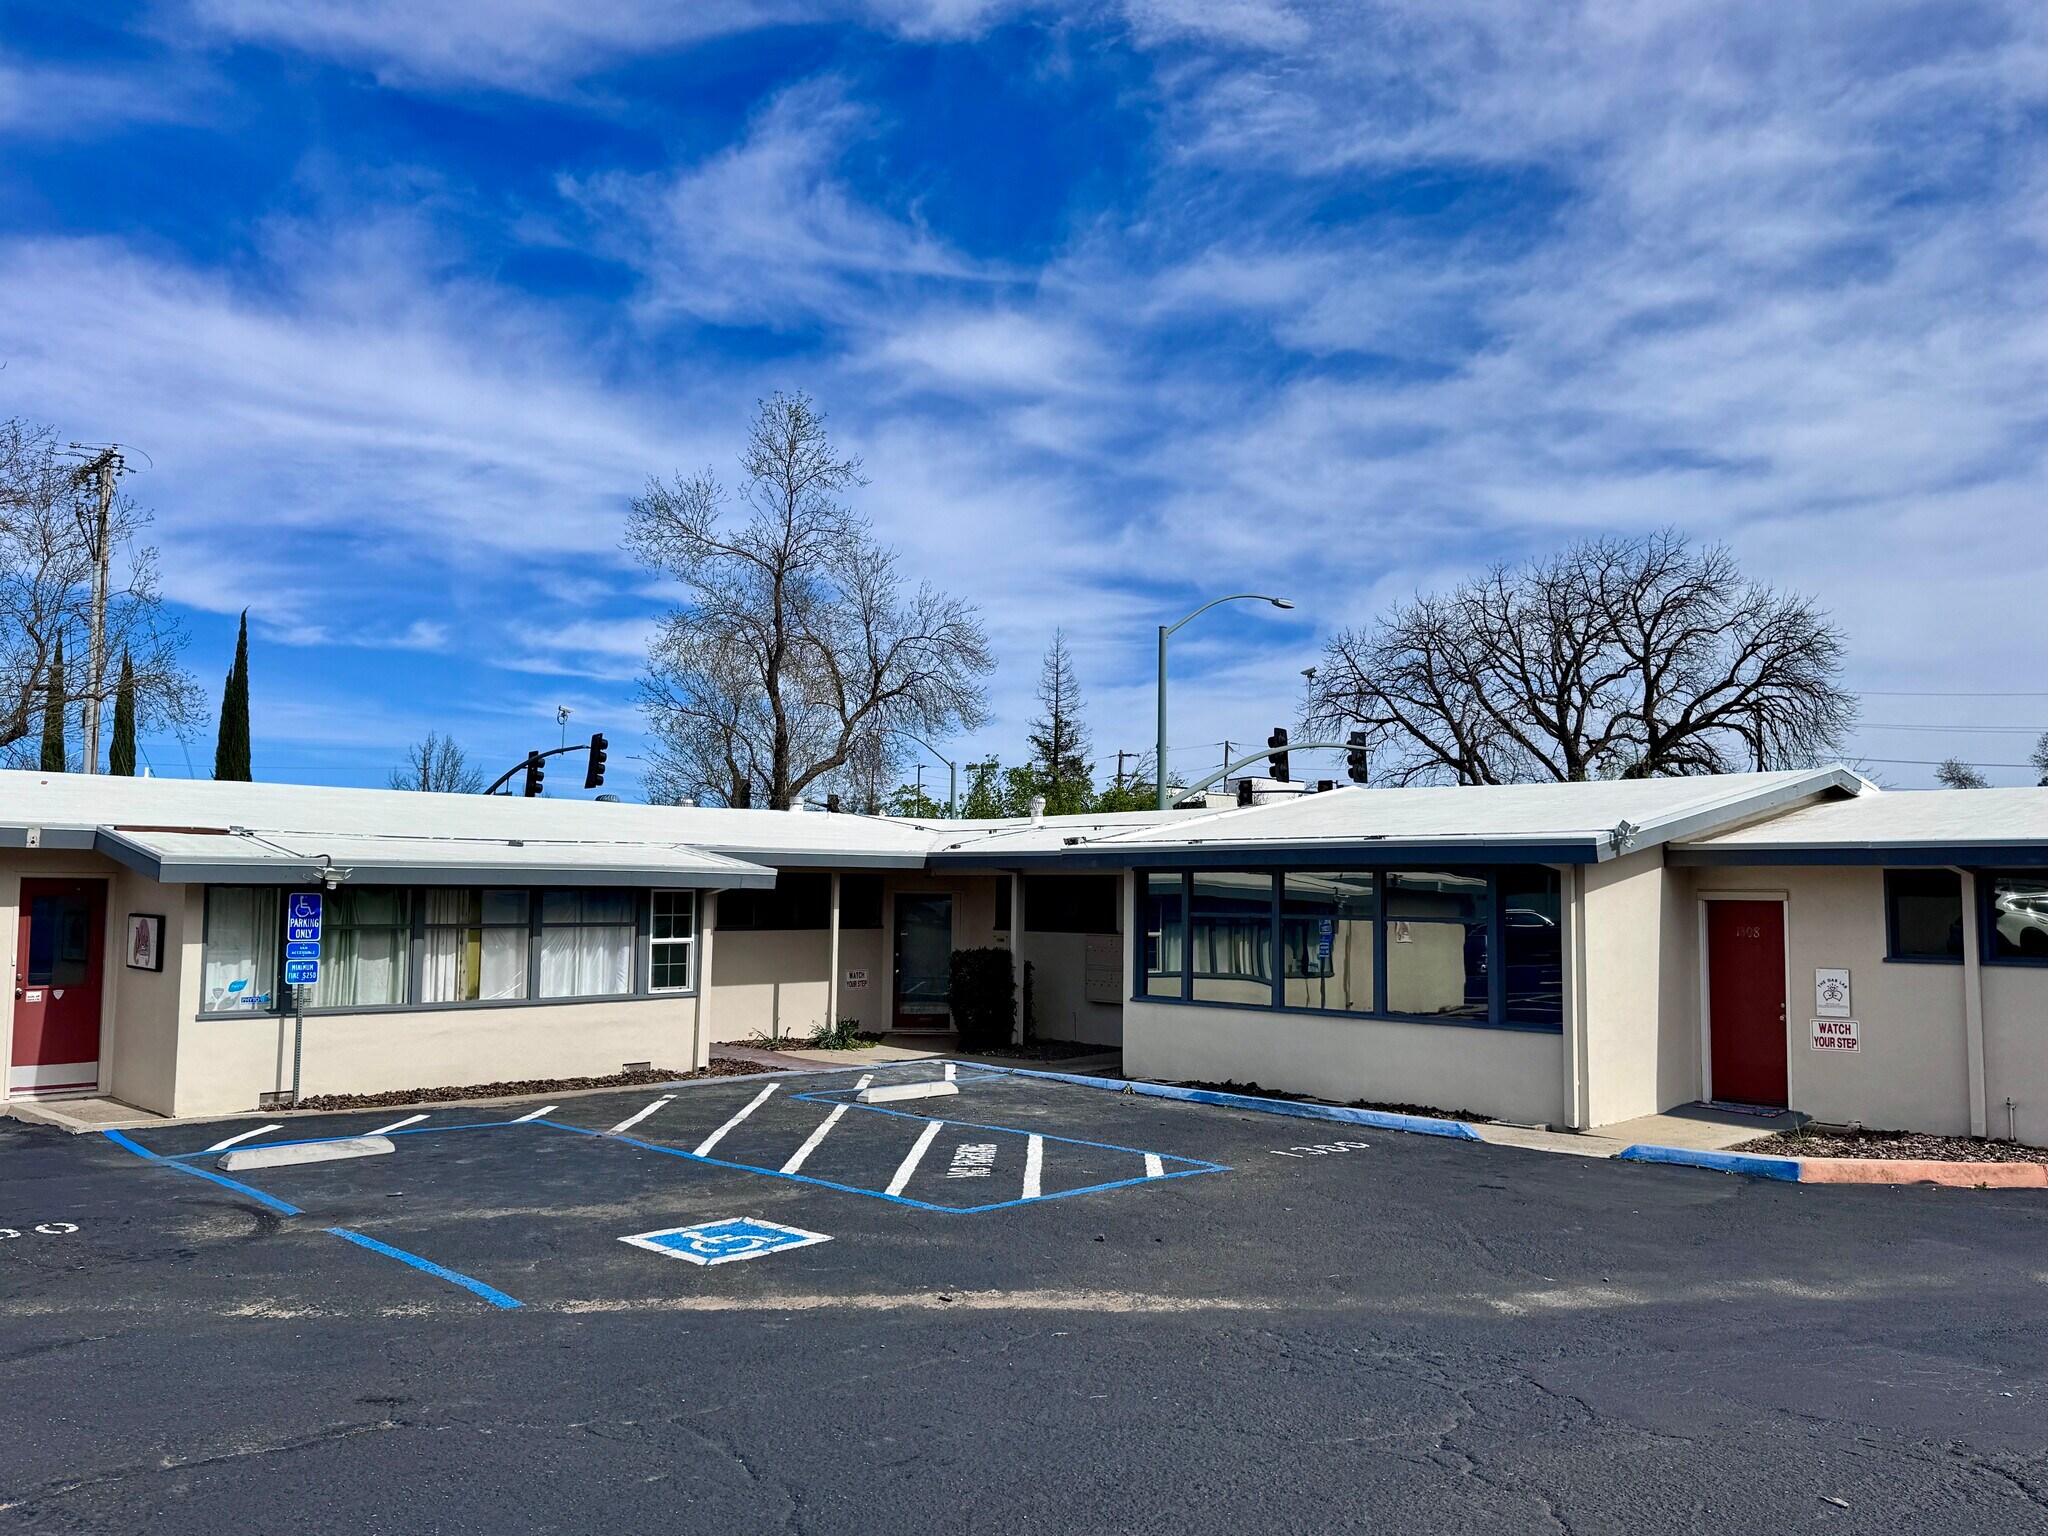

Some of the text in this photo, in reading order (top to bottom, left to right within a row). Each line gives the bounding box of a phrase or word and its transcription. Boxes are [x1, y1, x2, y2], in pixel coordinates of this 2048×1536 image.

[290, 918, 319, 927] PARKING
[295, 929, 313, 938] ONLY
[302, 971, 317, 979] $250
[848, 971, 865, 979] WATCH
[1818, 1023, 1851, 1035] WATCH
[1813, 1036, 1857, 1049] YOUR STEP
